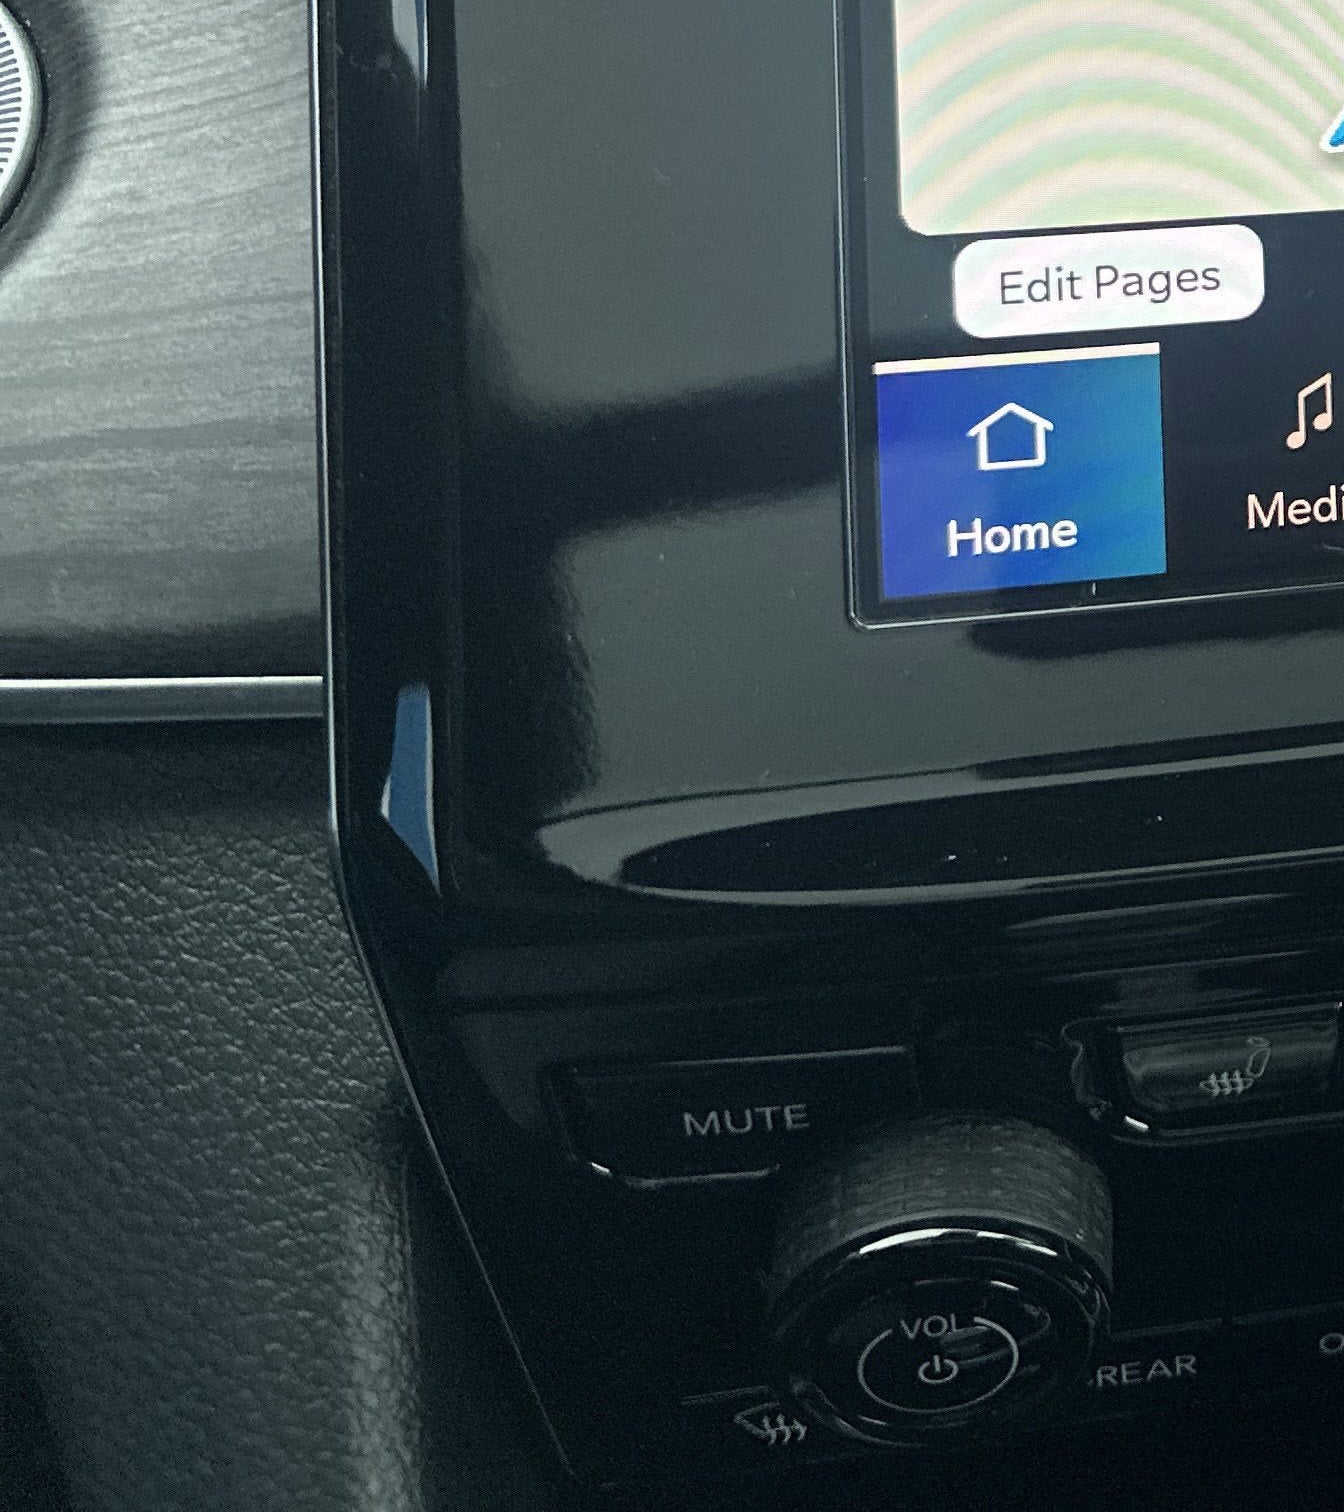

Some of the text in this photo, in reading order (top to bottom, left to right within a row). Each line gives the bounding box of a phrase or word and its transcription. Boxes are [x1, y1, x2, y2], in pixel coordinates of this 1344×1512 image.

[999, 261, 1222, 306] Edit Pages
[947, 517, 1079, 558] Home
[682, 1103, 812, 1138] MUTE
[899, 1313, 961, 1340] VOL
[1096, 1354, 1198, 1389] REAR
